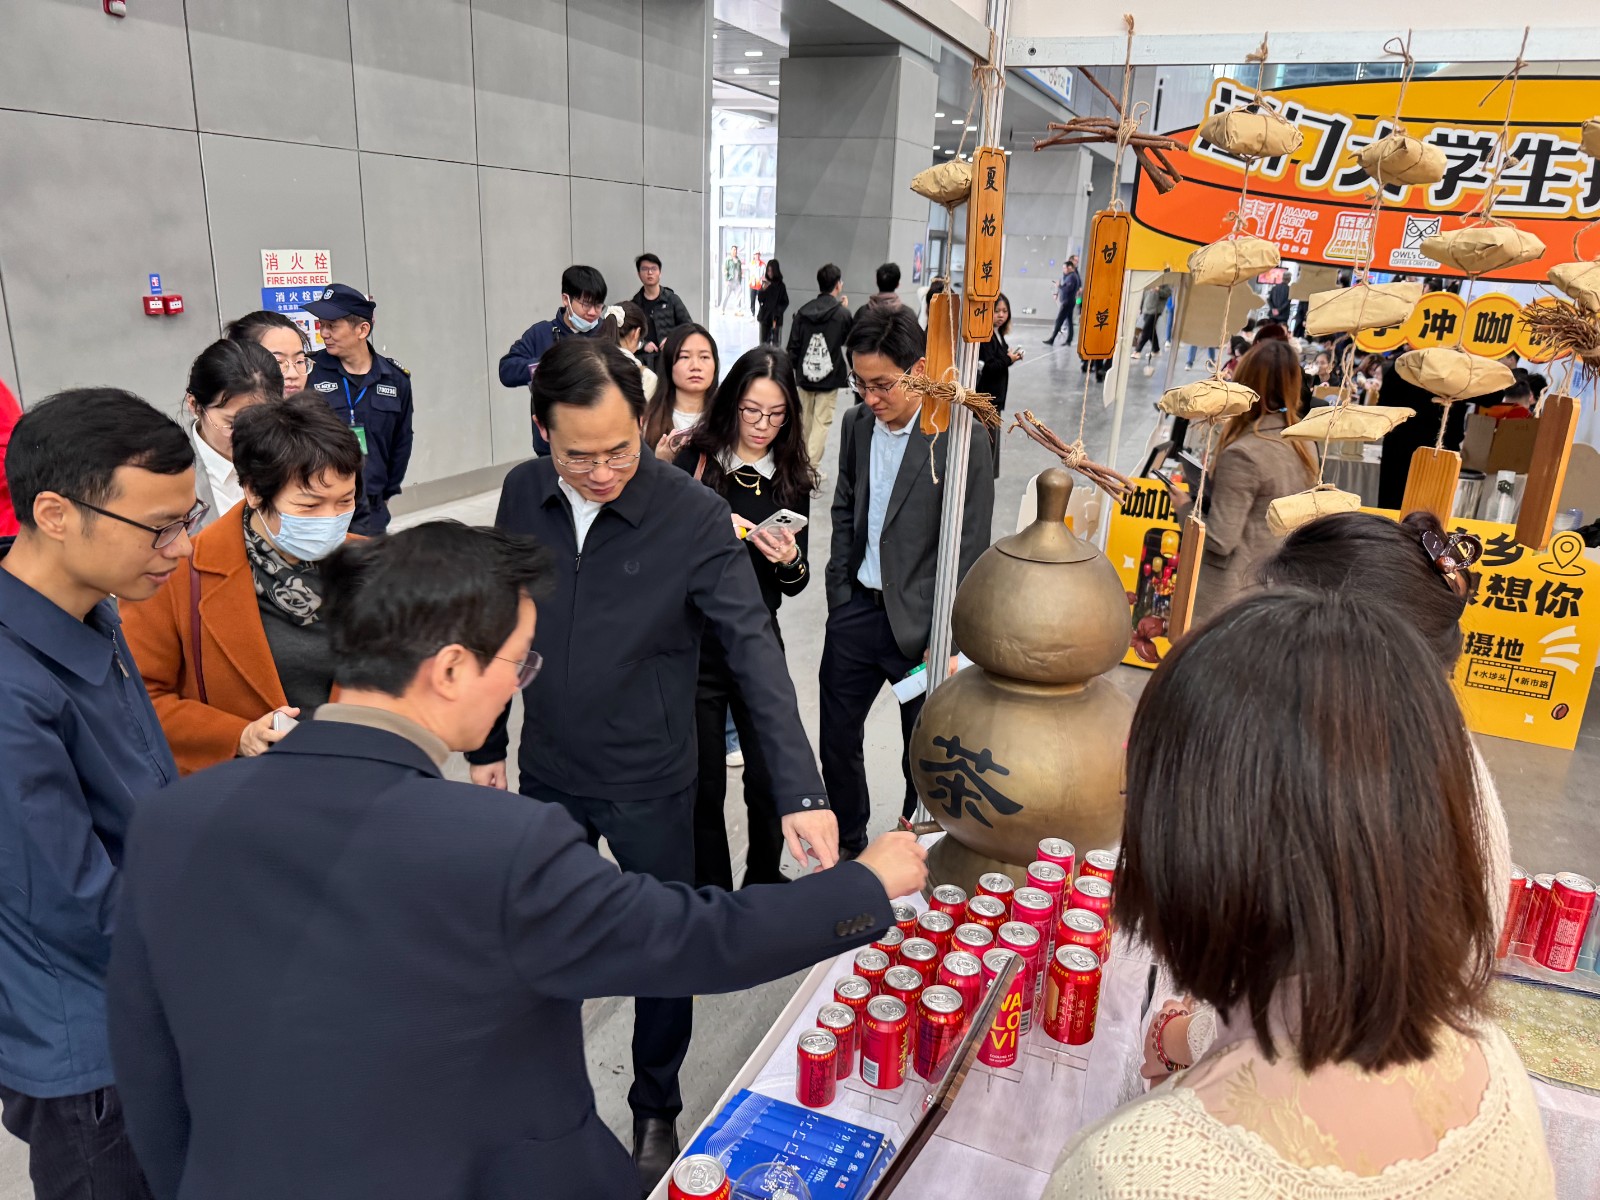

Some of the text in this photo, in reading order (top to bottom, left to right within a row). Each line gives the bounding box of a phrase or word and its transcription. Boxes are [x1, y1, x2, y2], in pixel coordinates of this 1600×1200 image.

[1200, 87, 1600, 210] 门大学生
[1281, 216, 1305, 227] MEN
[1284, 206, 1318, 220] JIANG
[1276, 225, 1312, 244] 江门
[265, 252, 328, 271] 消火栓
[266, 275, 329, 285] FIRE HOSE REEL
[1093, 242, 1117, 332] 甘草
[275, 291, 311, 303] 消火栓
[974, 302, 988, 324] 叶
[1468, 572, 1584, 619] 想你
[919, 735, 1024, 829] 茶
[991, 1011, 1020, 1031] LO
[990, 1031, 1016, 1050] VI
